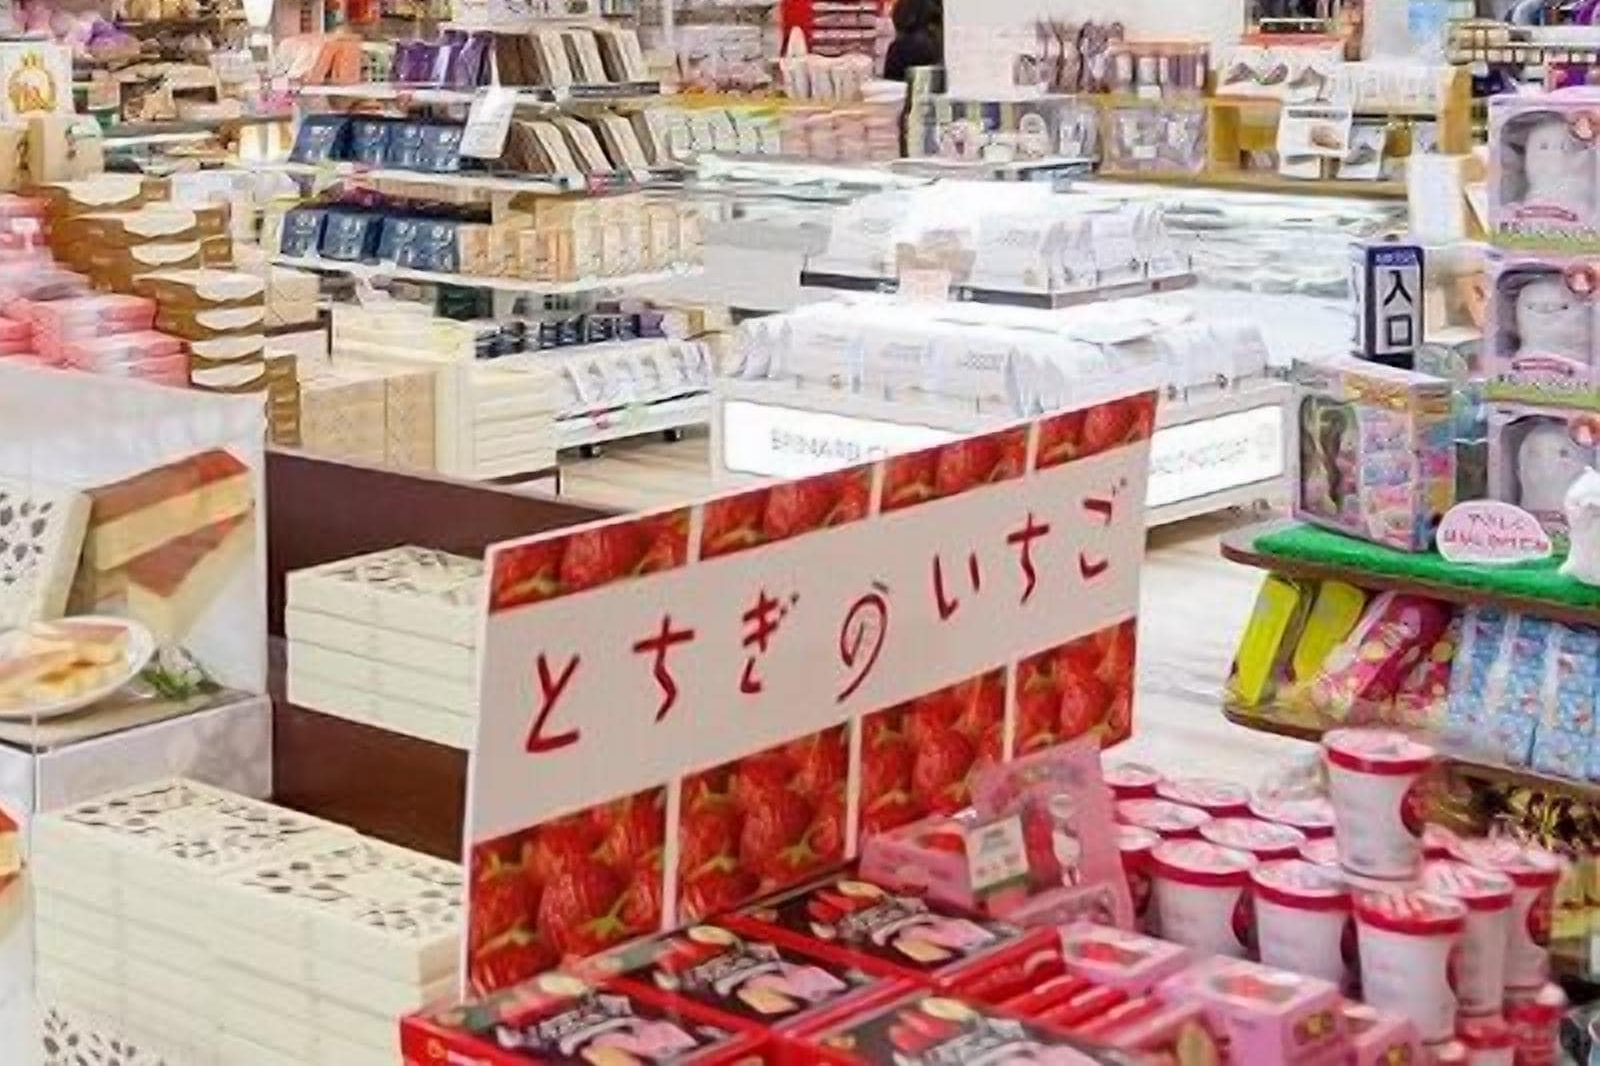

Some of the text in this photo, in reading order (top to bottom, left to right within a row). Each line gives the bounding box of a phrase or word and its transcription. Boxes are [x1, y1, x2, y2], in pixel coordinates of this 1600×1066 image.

[1383, 269, 1413, 347] 入口
[524, 478, 1129, 754] とちぎのいちご
